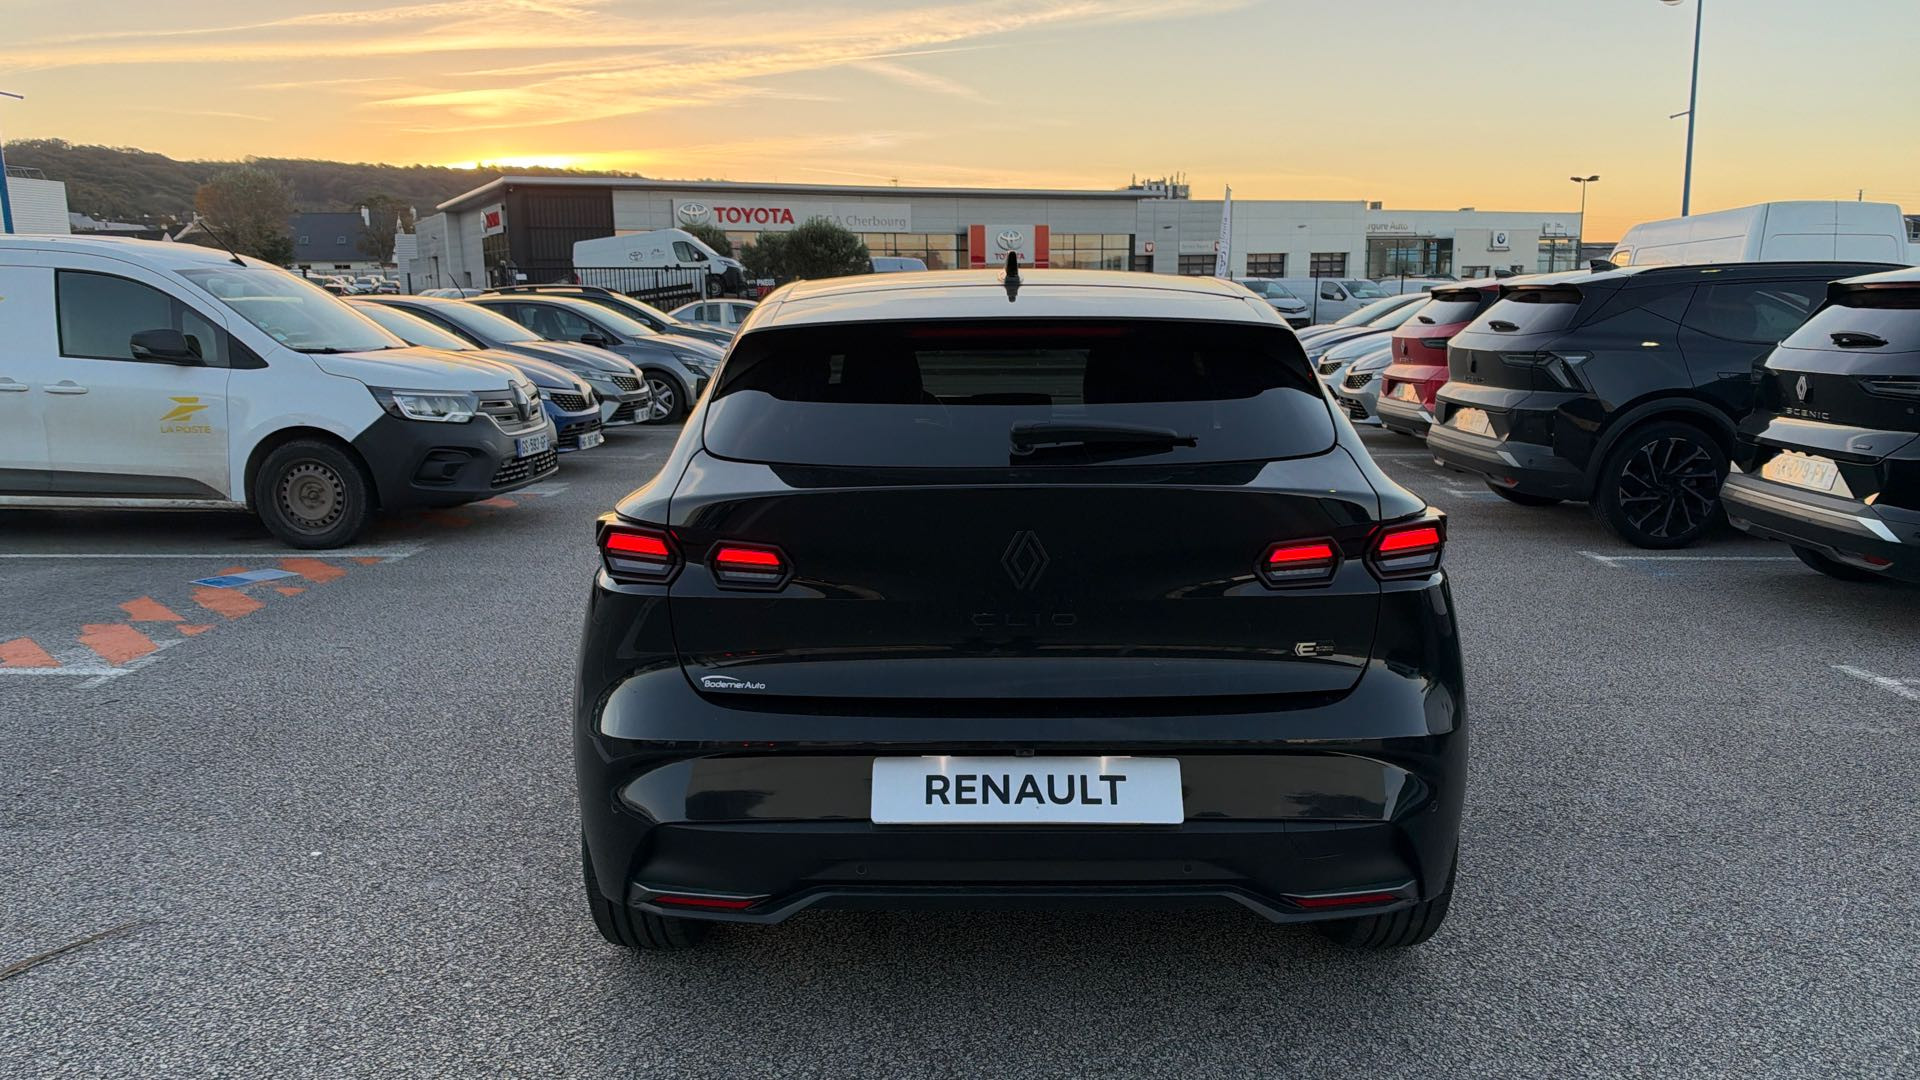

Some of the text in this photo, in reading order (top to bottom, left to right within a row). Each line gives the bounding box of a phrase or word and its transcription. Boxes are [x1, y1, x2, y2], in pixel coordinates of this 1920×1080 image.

[713, 206, 795, 225] TOYOTA
[846, 215, 907, 230] Cherbourg
[994, 252, 1025, 260] TOTA
[1785, 407, 1831, 420] SCENIC
[160, 425, 212, 434] LA POSTE
[970, 612, 1078, 627] CLIO
[925, 773, 1127, 806] RENAULT
